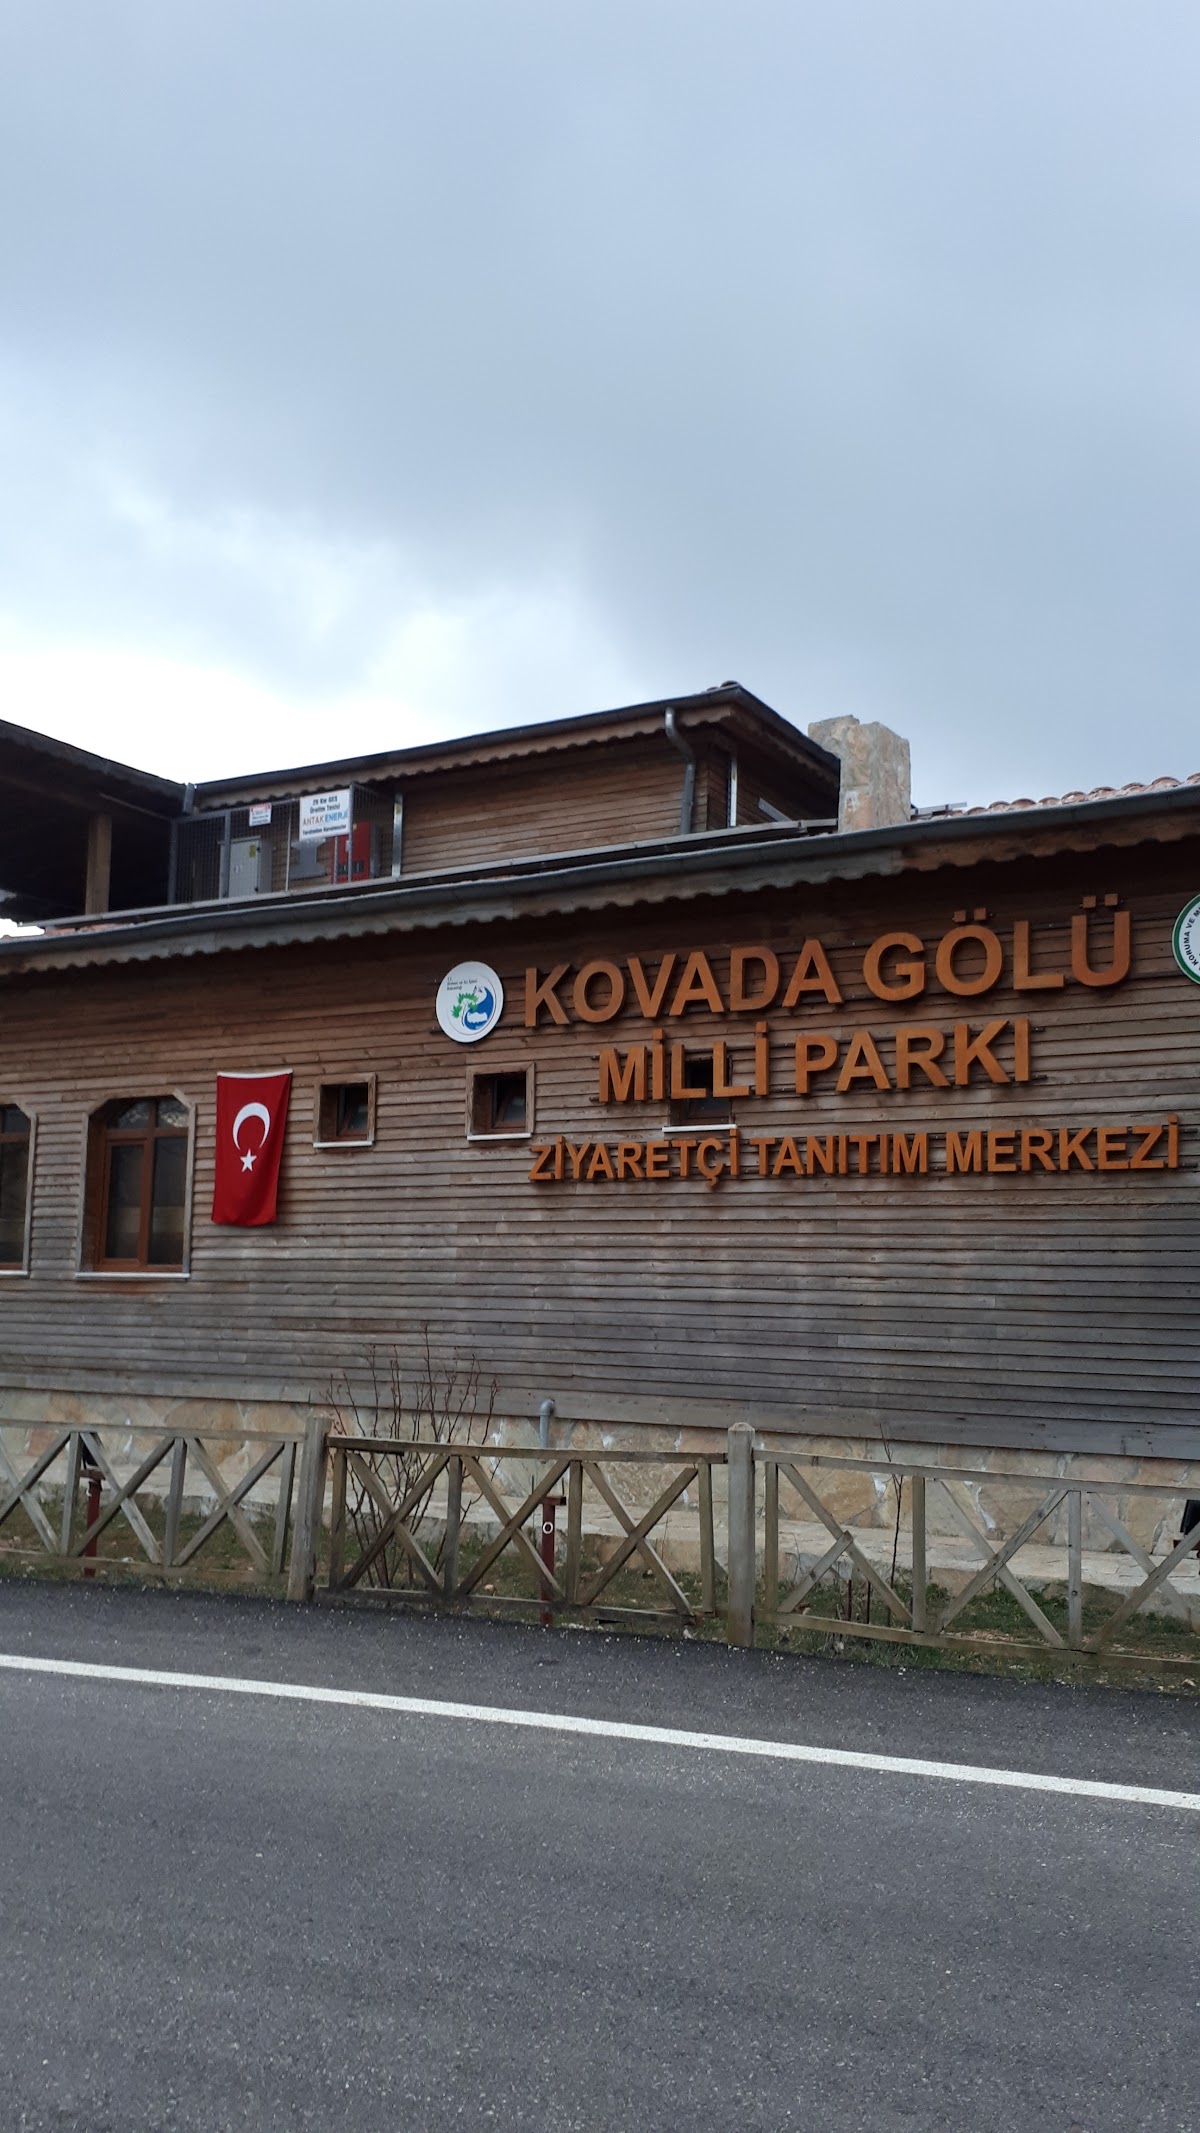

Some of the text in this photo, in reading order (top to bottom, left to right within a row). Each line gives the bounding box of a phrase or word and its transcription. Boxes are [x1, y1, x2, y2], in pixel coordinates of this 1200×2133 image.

[303, 816, 324, 826] ANTAK
[1184, 931, 1198, 966] KORUMA
[1186, 918, 1195, 928] VE
[524, 893, 1131, 1029] KOVADA GÖLÜ
[599, 1018, 1031, 1103] MİLLİ PARKI
[528, 1114, 1180, 1188] ZİYARETÇİ TANITIM MERKEZİ
